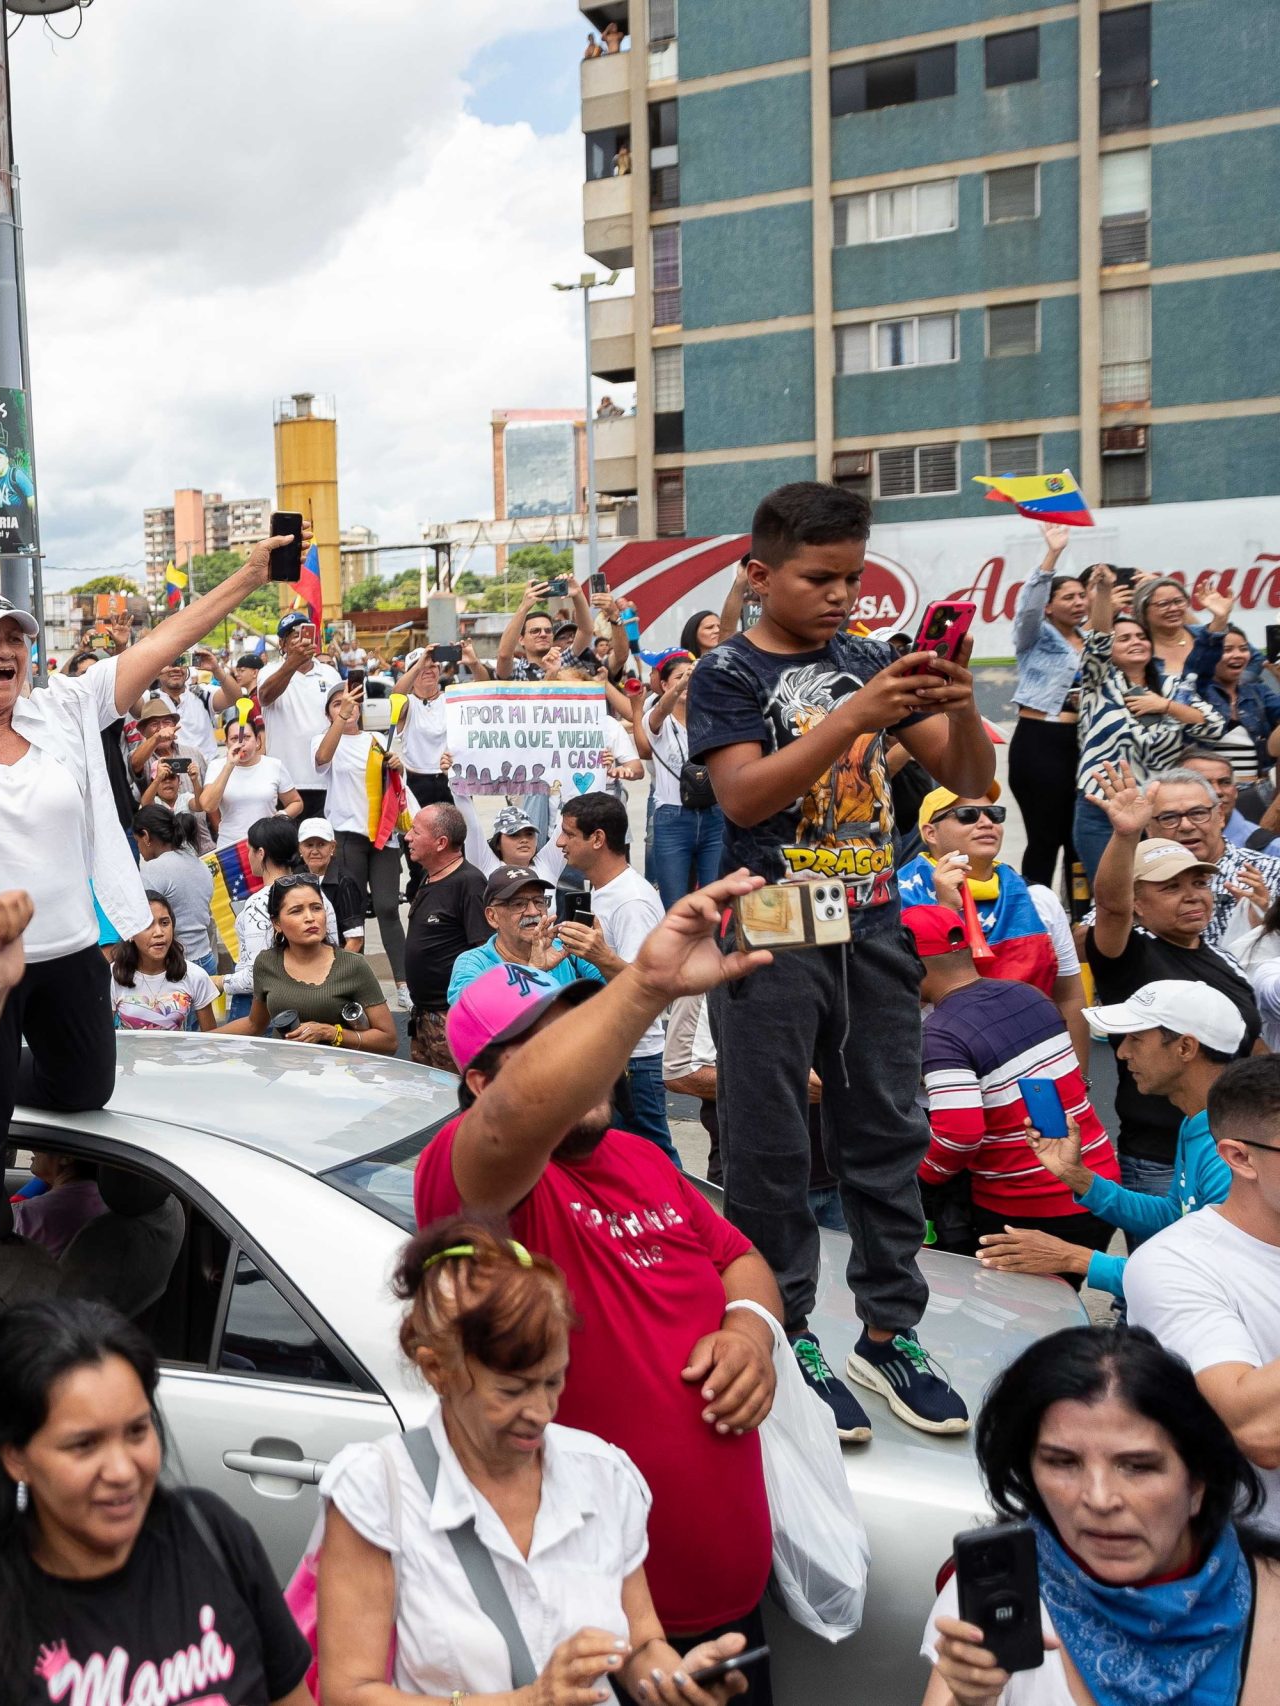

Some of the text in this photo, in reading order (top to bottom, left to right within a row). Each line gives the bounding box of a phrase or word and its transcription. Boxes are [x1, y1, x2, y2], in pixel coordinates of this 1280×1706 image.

[460, 705, 599, 725] ¡POR MI FAMILIA!
[467, 730, 605, 749] PARA QUE VUELVA
[550, 750, 561, 769] A
[47, 1604, 235, 1706] Mamá
